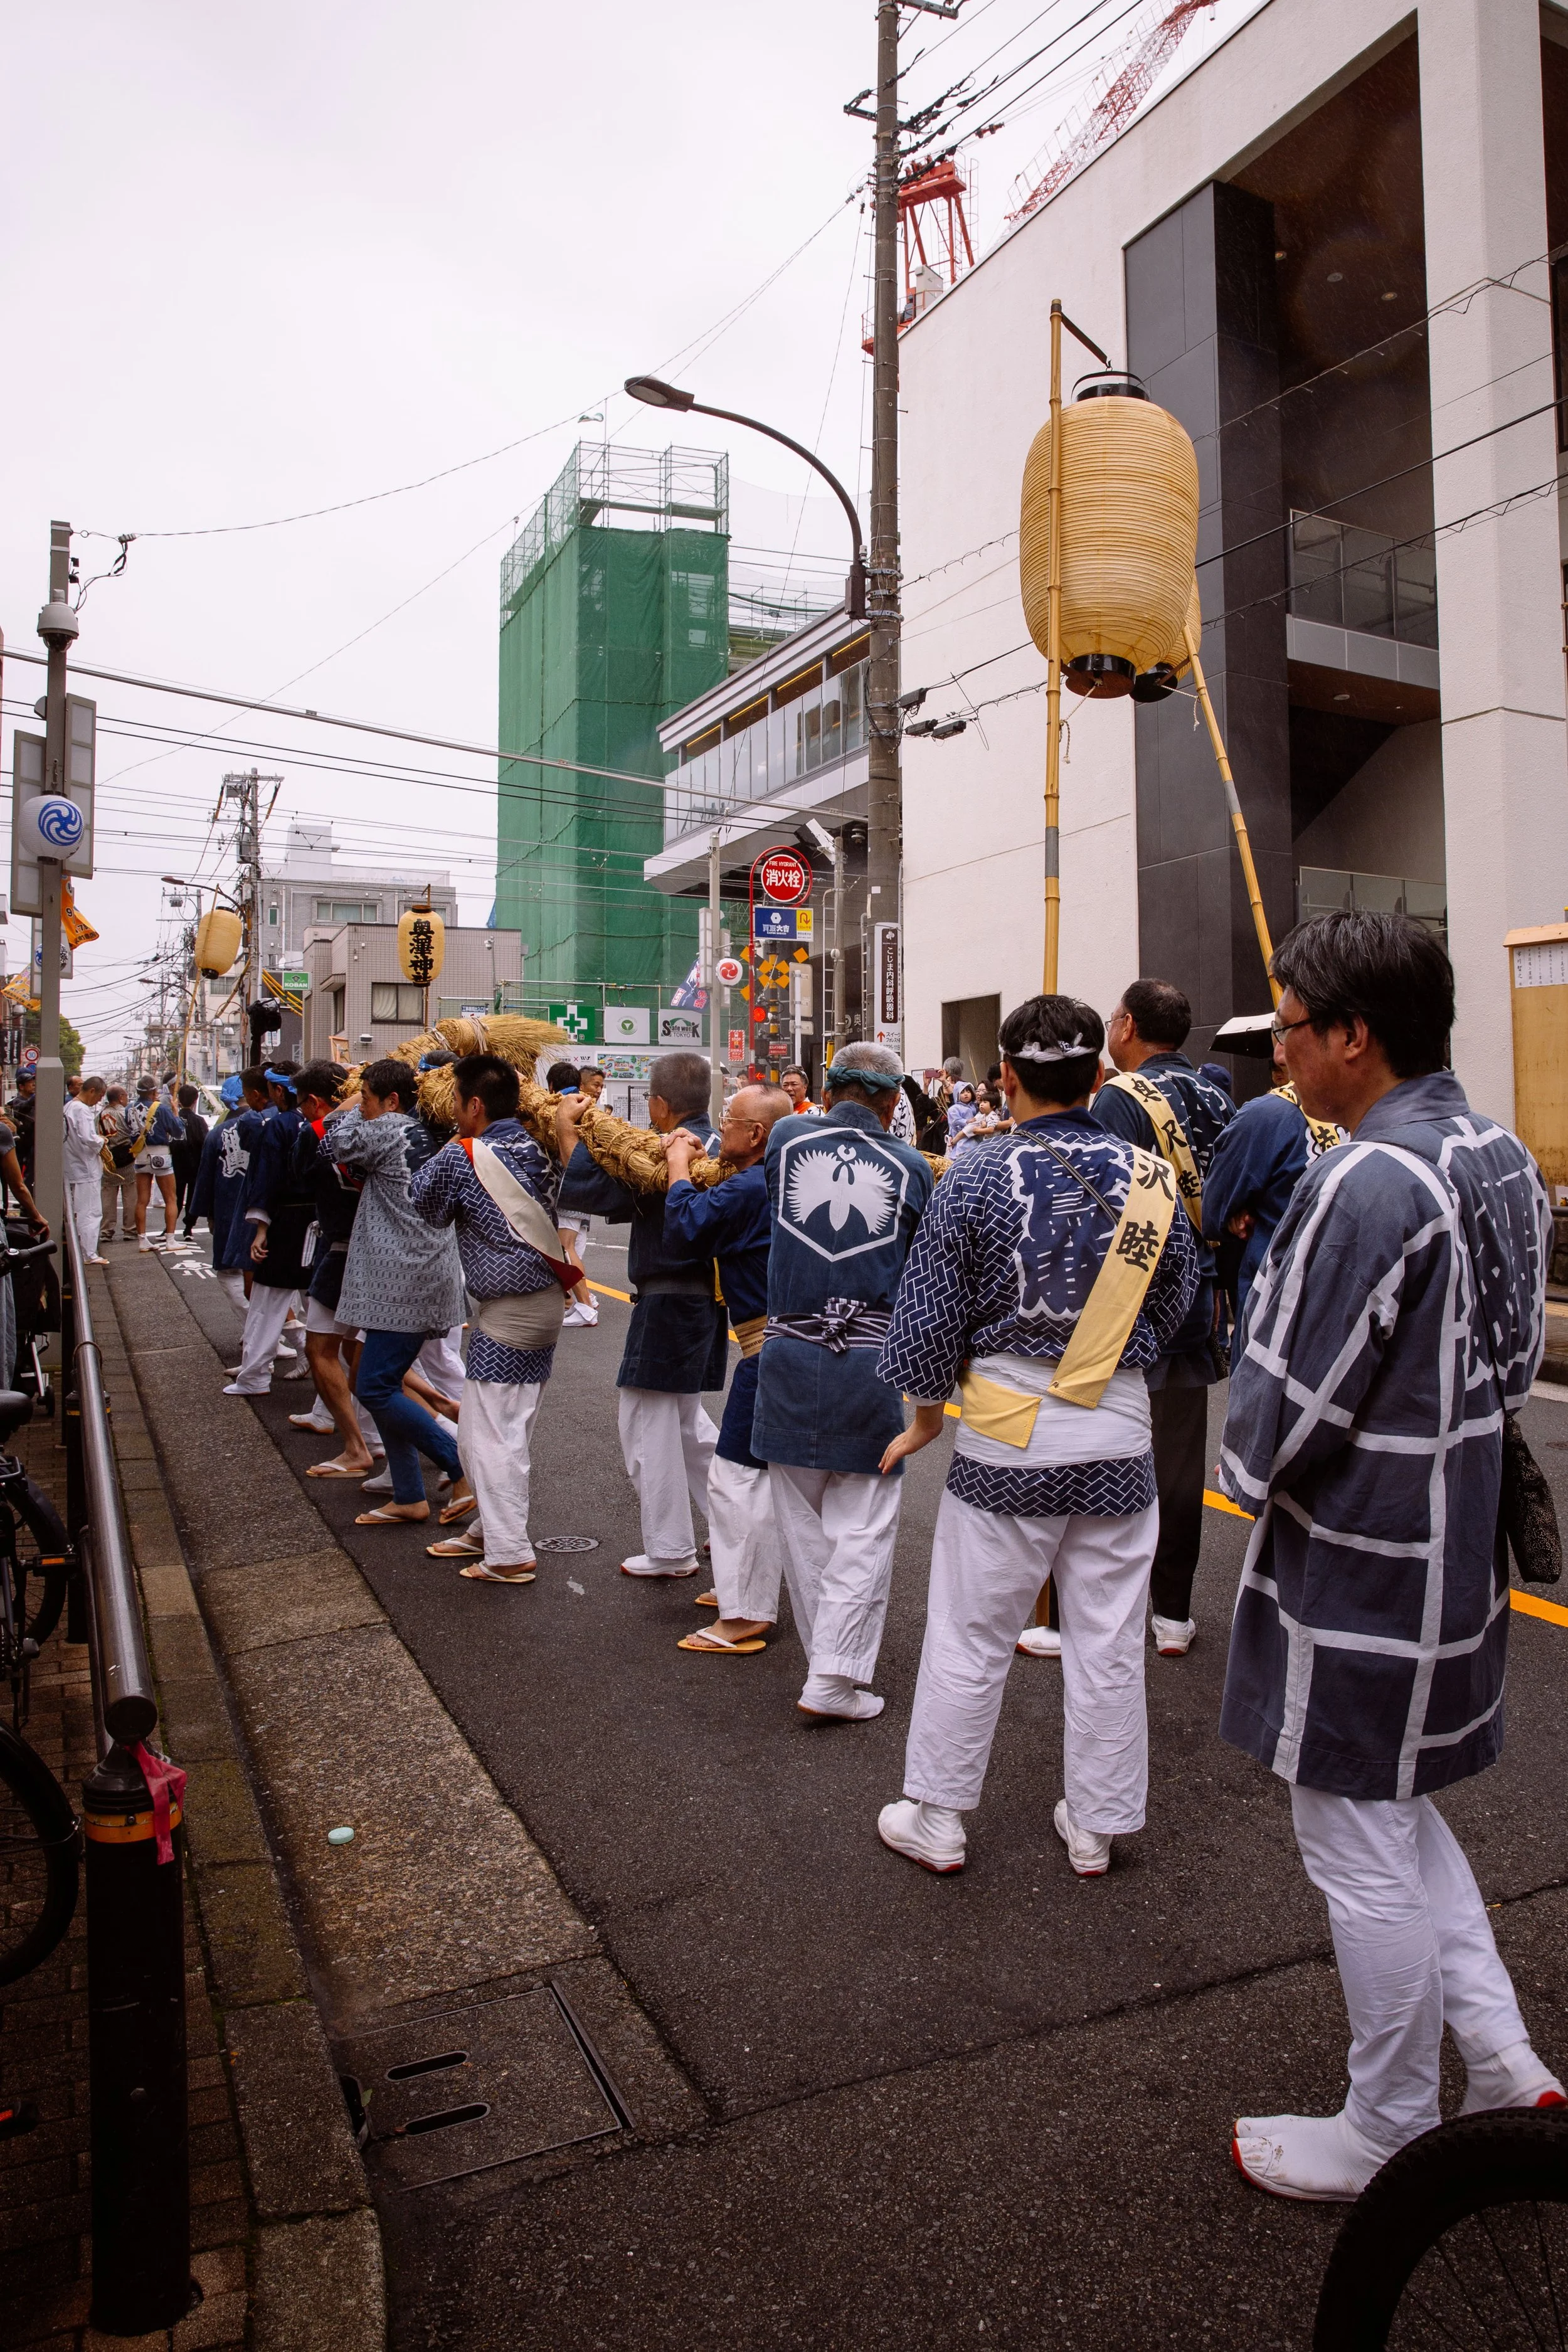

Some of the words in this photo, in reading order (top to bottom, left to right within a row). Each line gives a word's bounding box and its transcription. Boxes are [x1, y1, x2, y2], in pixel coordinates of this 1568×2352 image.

[766, 869, 801, 887] 消火栓
[886, 947, 894, 1020] こじま内科呼吸器科
[1115, 1152, 1175, 1273] 沢睦
